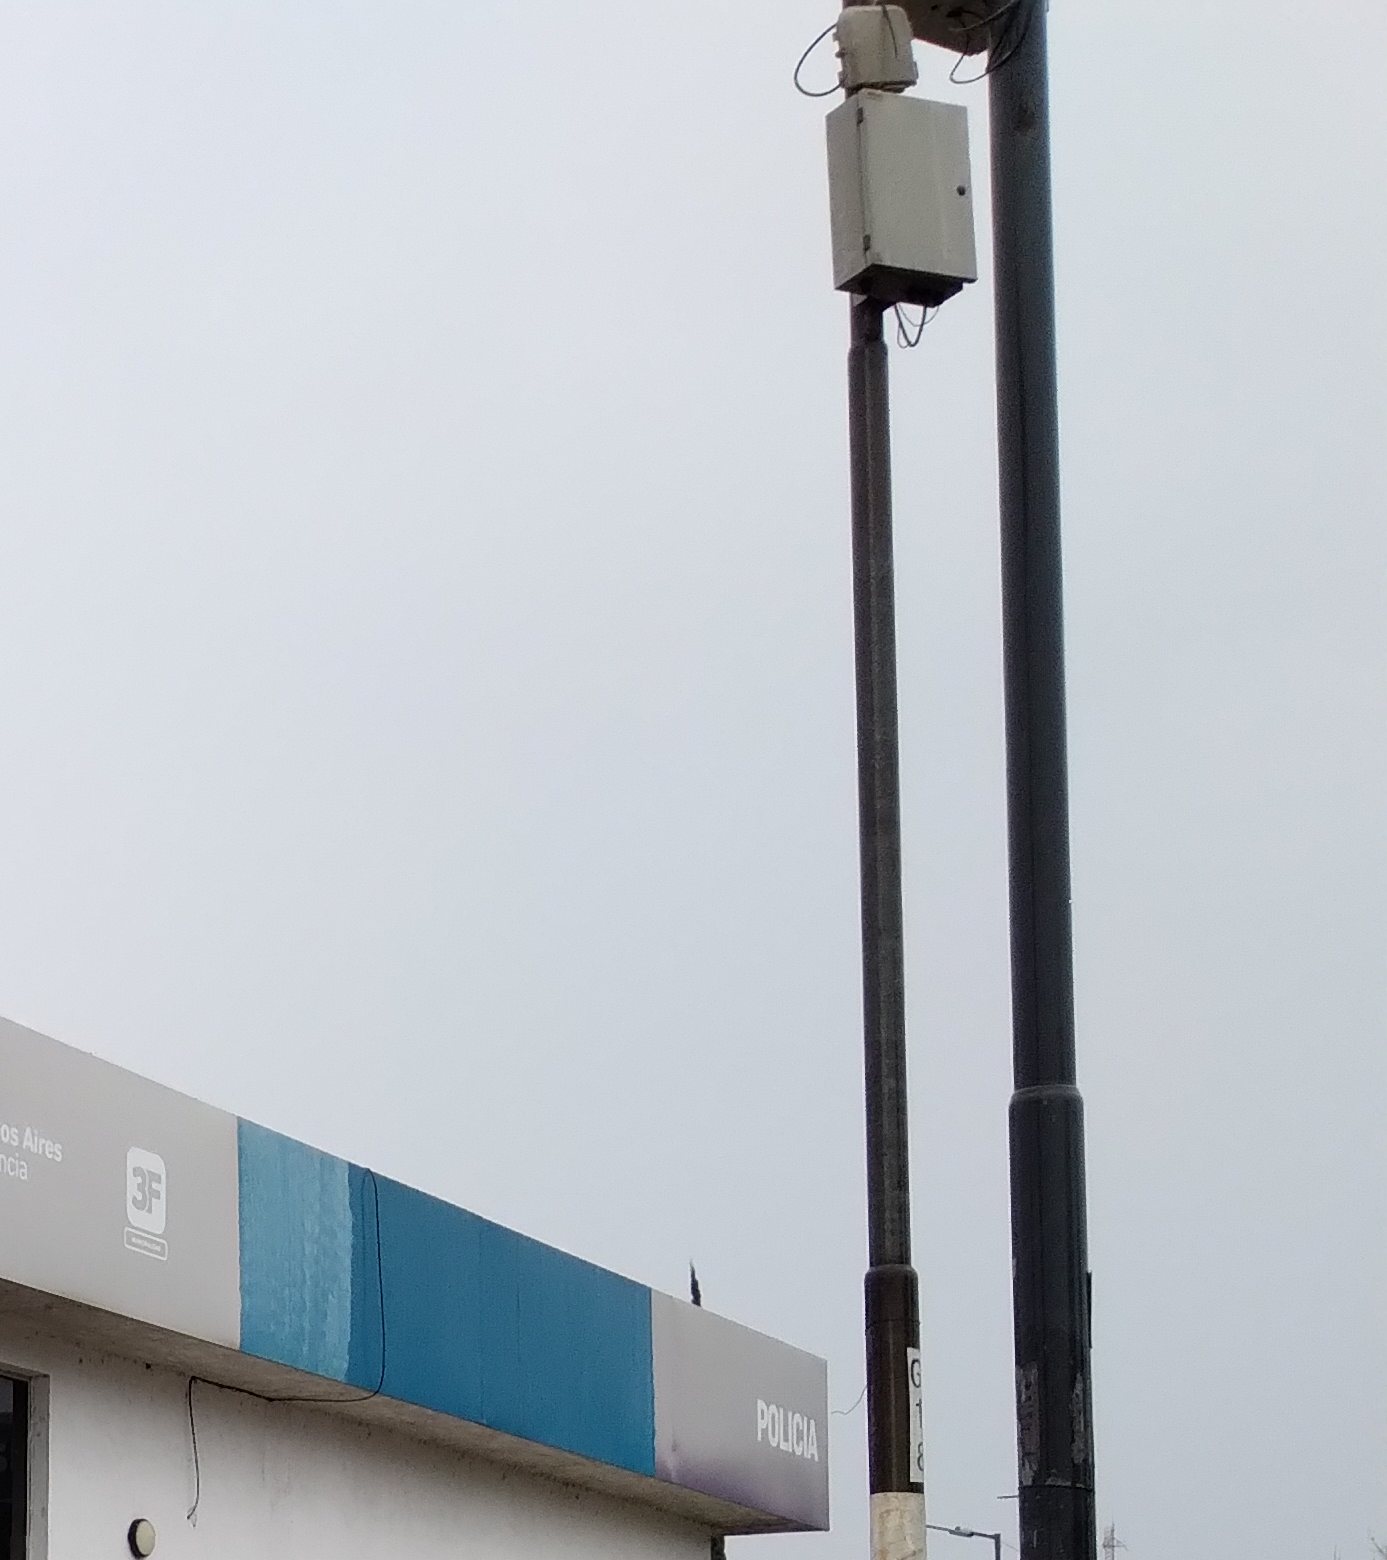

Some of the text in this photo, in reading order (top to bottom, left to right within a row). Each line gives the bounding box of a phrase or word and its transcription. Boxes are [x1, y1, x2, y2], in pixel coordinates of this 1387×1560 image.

[22, 1127, 63, 1162] Aires
[131, 1166, 162, 1214] 3F
[757, 1399, 819, 1462] POLICIA
